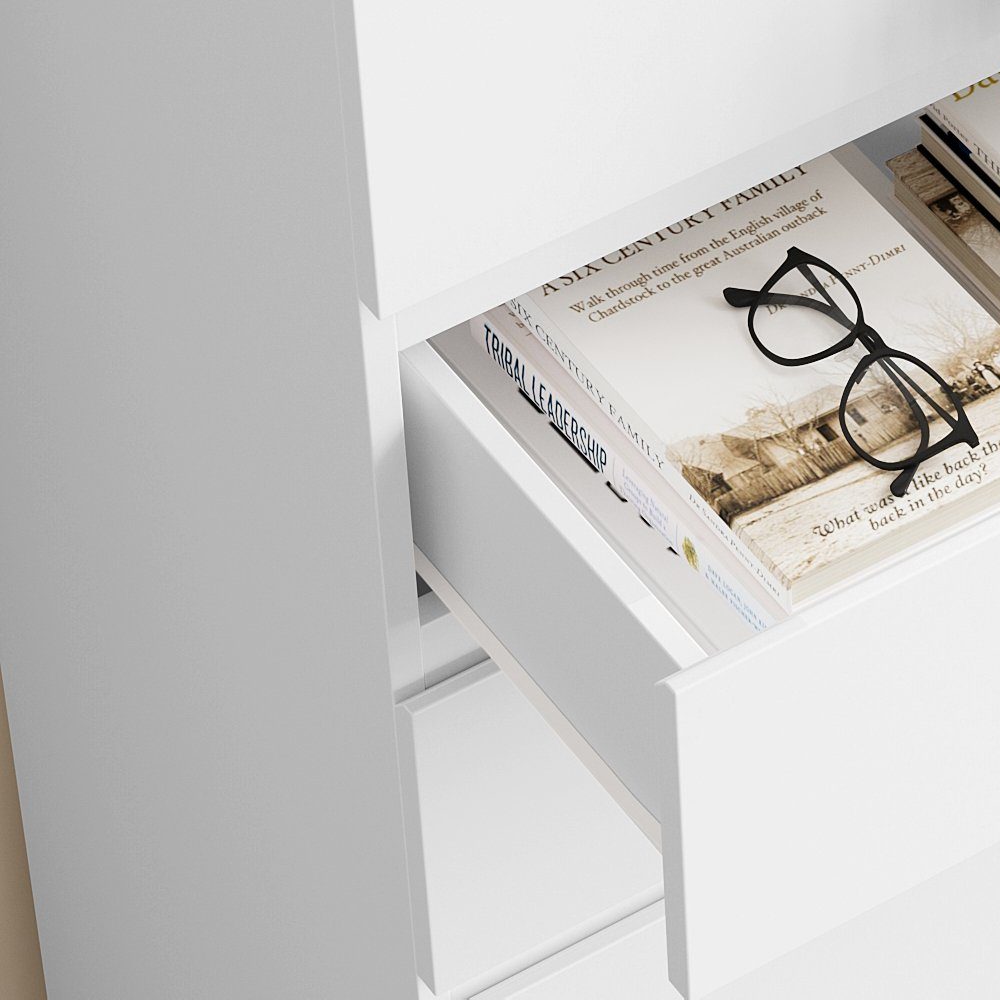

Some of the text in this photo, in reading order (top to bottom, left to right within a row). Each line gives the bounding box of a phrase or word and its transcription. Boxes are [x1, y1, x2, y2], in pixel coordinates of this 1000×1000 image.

[568, 188, 823, 313] Walk through time from the English village of
[588, 206, 827, 323] Chardstock to the great Australian outback
[828, 244, 907, 286] PNNY-DIMRI
[483, 323, 608, 474] TRIBAL LEADERSHIP
[509, 298, 532, 327] SIX
[535, 324, 604, 403] CENTURY
[608, 403, 664, 469] FAMILY
[812, 509, 862, 538] What
[863, 493, 895, 514] was
[906, 471, 941, 490] like
[942, 450, 980, 475] back
[868, 506, 906, 530] back
[908, 498, 925, 511] in
[927, 484, 950, 502] the
[954, 463, 987, 489] day?
